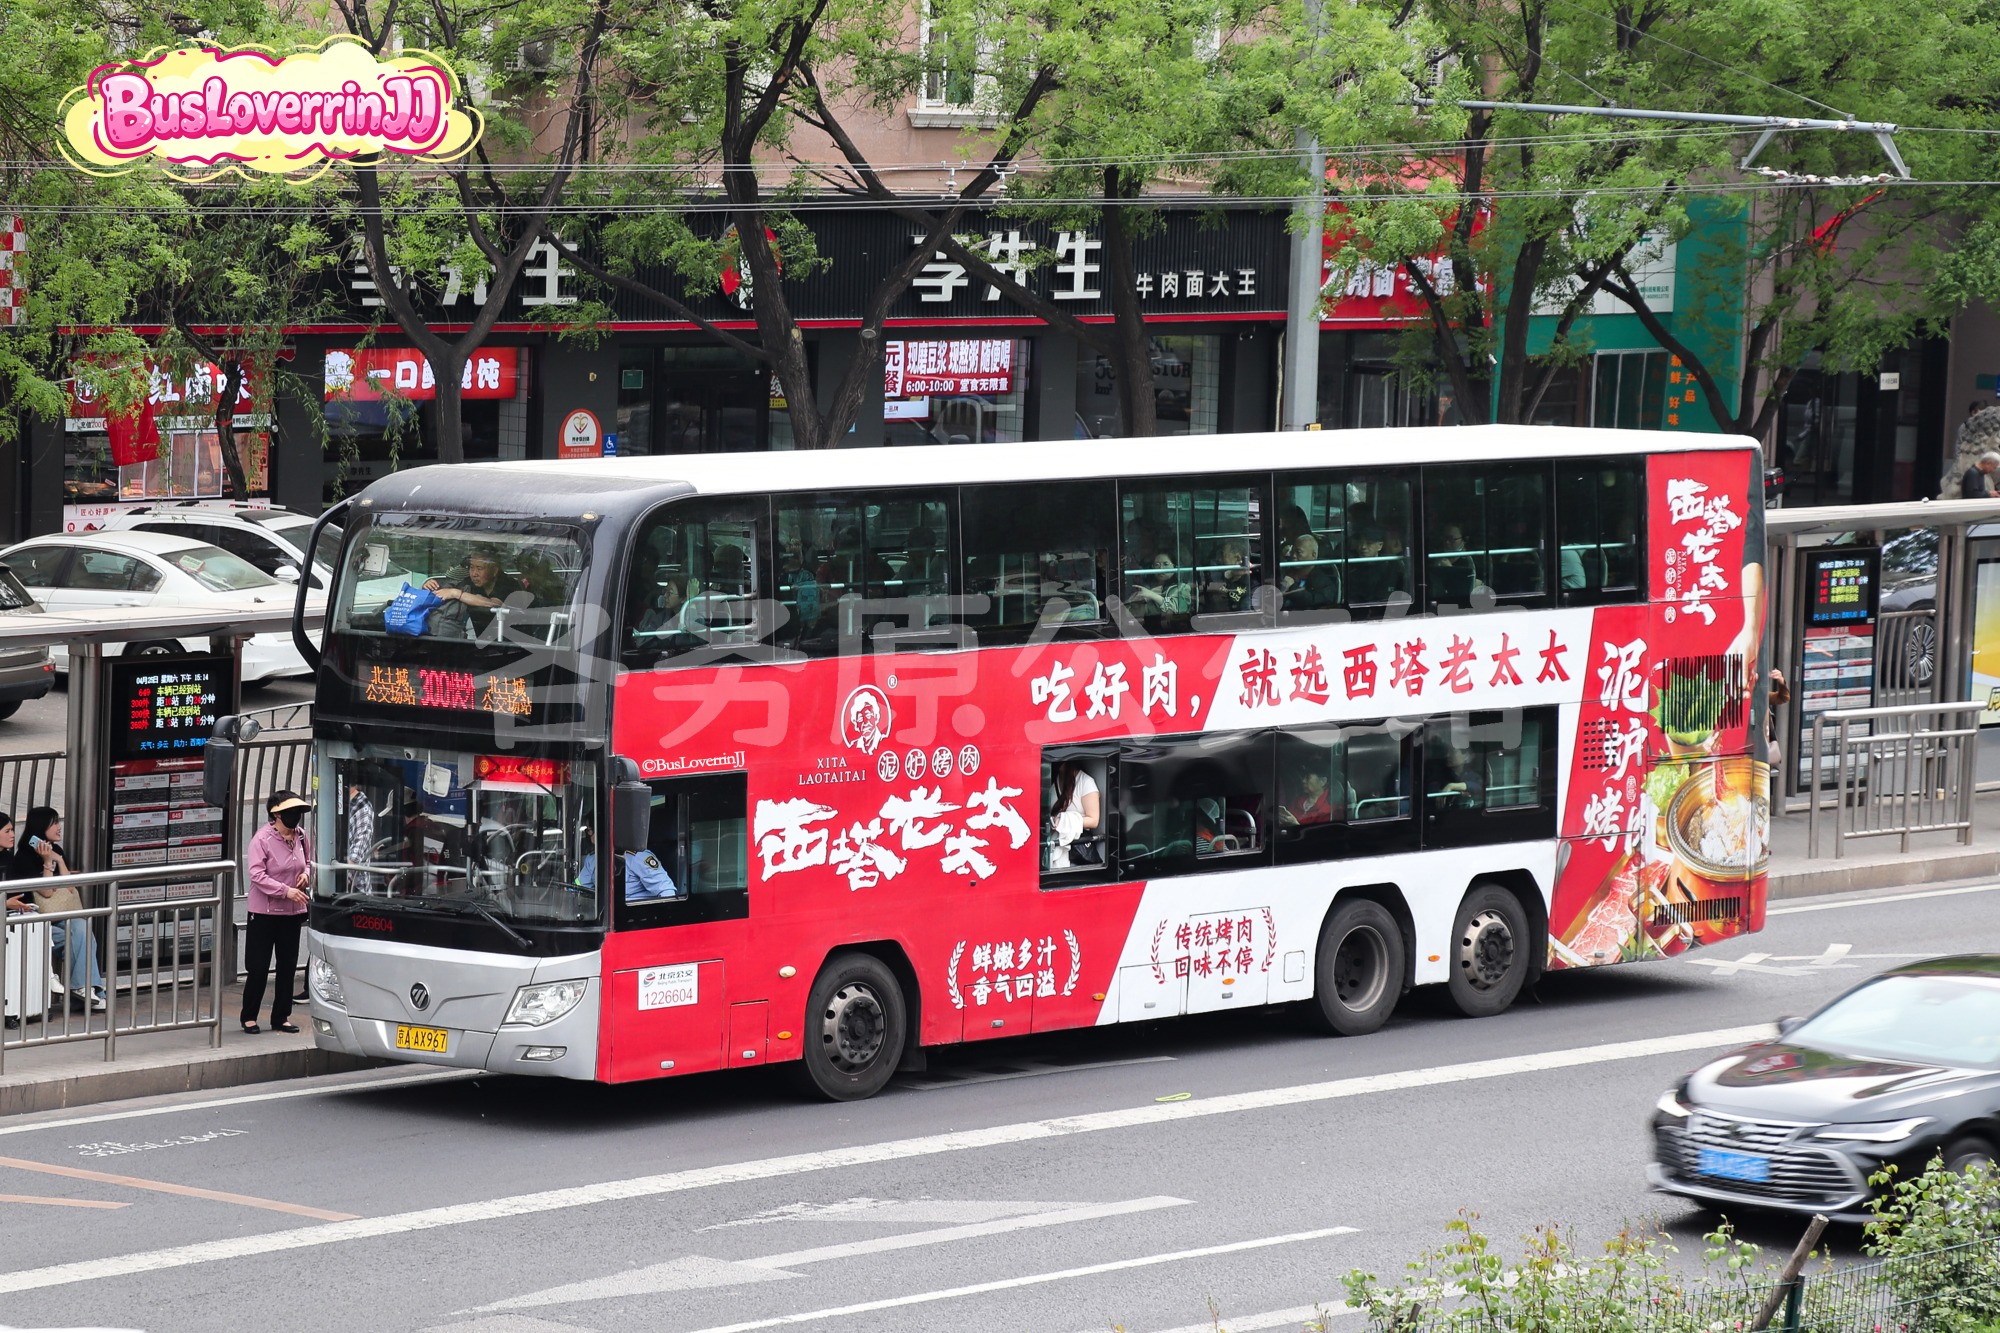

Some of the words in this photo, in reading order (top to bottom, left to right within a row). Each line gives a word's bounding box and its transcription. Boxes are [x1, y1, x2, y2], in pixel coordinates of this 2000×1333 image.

[1136, 269, 1257, 299] 牛肉面大王
[907, 340, 947, 375] 现磨豆浆
[905, 380, 955, 393] 6:00-10:00
[959, 377, 1009, 392] 堂食无限量
[370, 665, 410, 686] 北土城
[1237, 628, 1571, 711] 就选西塔老太太
[157, 684, 202, 696] 车辆已经到站
[365, 683, 416, 706] 公交场站
[486, 675, 527, 697] 北土城
[156, 705, 202, 718] 车辆已经到站
[481, 693, 533, 716] 公交场站
[817, 757, 847, 769] XITA
[878, 746, 980, 782] 泥炉烤肉
[799, 769, 866, 786] LAOTAITAI
[753, 776, 1032, 892] 西塔老太太
[351, 915, 393, 933] 1226604
[1174, 915, 1253, 951] 传统烤肉
[971, 936, 1057, 974] 鲜嫩多汁
[1174, 946, 1255, 980] 回味不停
[658, 970, 693, 981] 北京公交
[645, 988, 693, 1006] 1226604
[972, 971, 1057, 1006] 香气四溢
